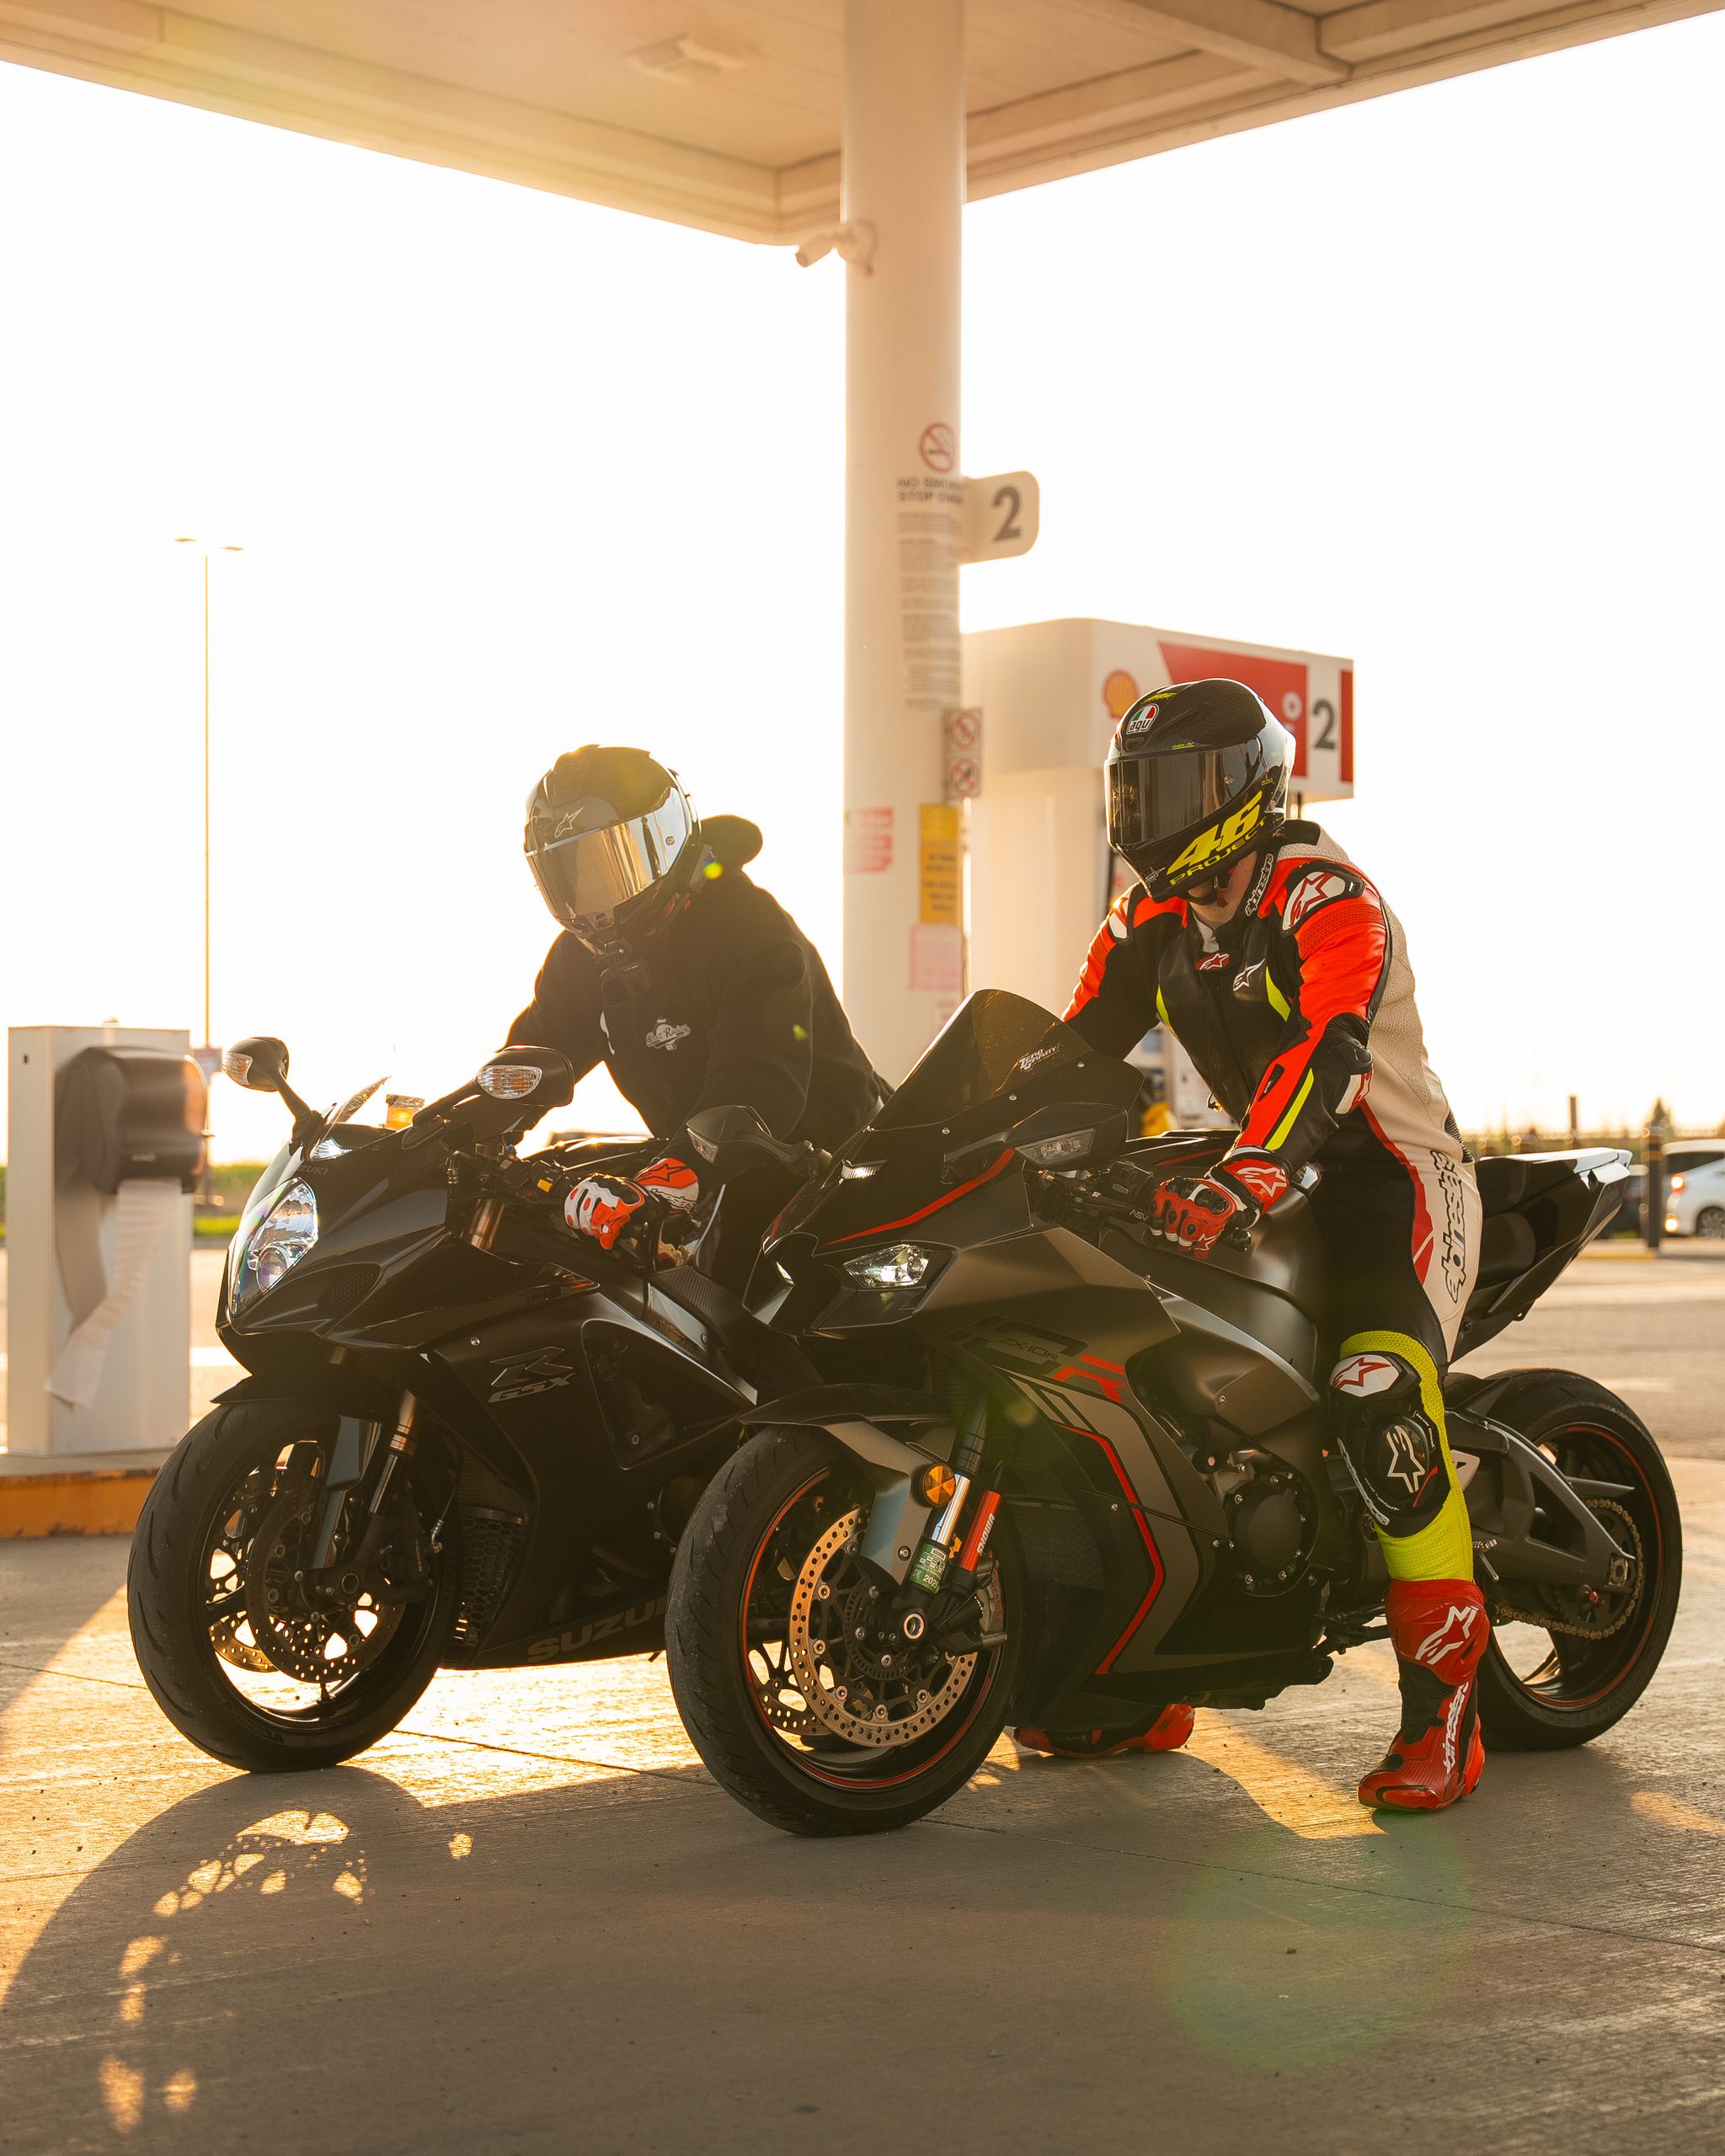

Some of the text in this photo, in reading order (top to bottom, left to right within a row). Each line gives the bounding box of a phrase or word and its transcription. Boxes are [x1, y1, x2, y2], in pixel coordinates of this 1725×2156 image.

[991, 486, 1023, 543] 2
[1130, 720, 1151, 732] agv
[1312, 698, 1337, 750] 2
[1167, 790, 1263, 875] 46
[1169, 815, 1267, 886] PROJECT
[1129, 1209, 1149, 1221] ASV
[997, 1334, 1059, 1362] ZX-10R
[488, 1372, 577, 1404] GSX
[976, 1513, 996, 1556] SHOWA
